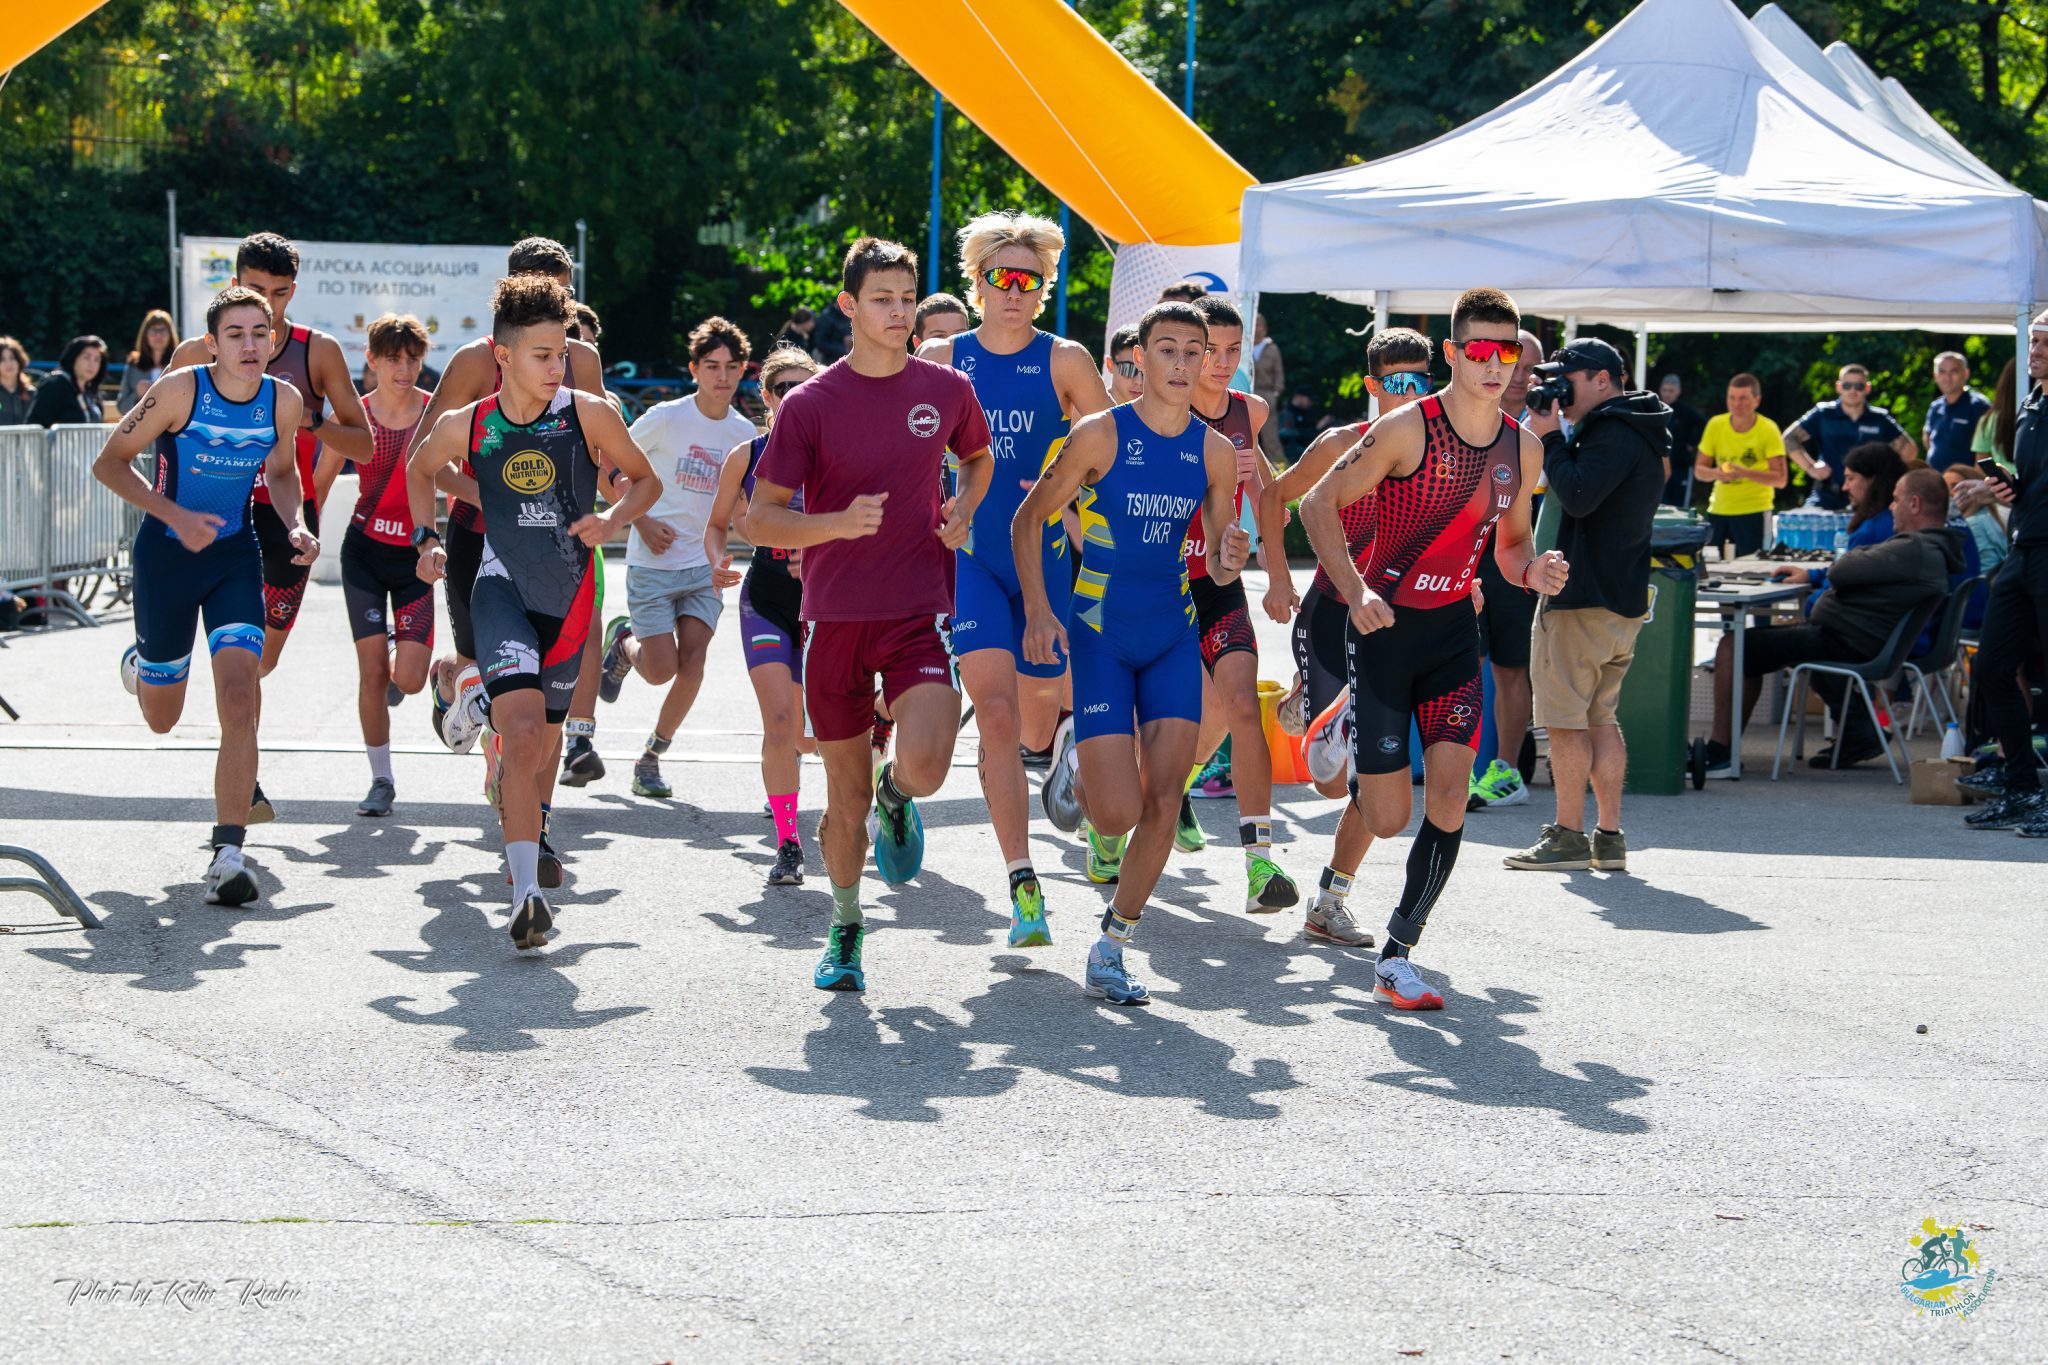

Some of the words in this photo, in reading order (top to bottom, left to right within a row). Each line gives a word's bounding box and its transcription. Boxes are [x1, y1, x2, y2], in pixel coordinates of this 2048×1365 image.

[299, 258, 366, 274] ЛГАРСКА
[370, 260, 480, 277] АСОЦИАЦИЯ
[317, 280, 345, 295] ПО
[350, 281, 436, 297] ТРИАТЛОН
[985, 408, 1035, 433] YLOV
[510, 469, 549, 480] NUTRITION
[511, 458, 545, 472] GOLD
[1126, 493, 1197, 520] TSIVKOVSKY
[373, 518, 407, 537] BUL
[1142, 521, 1172, 544] UKR
[1184, 539, 1207, 557] BU
[1414, 573, 1452, 592] BUL
